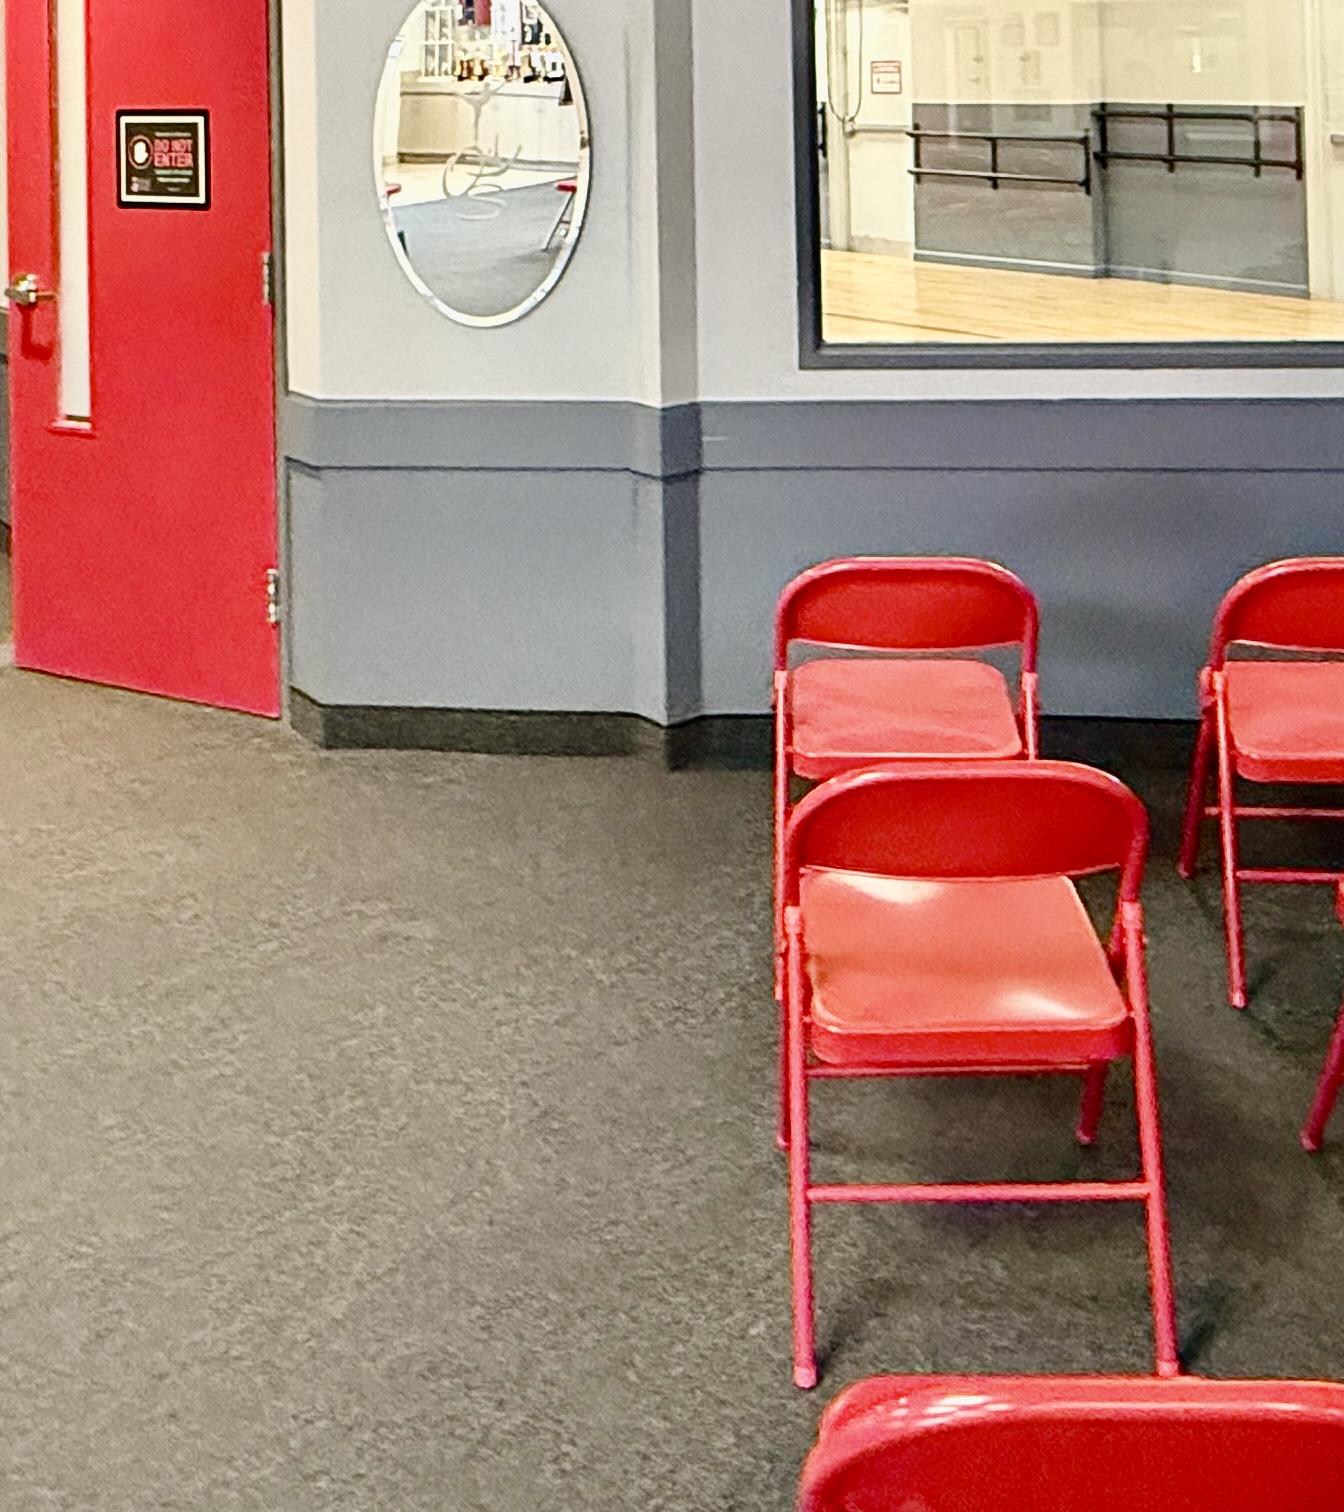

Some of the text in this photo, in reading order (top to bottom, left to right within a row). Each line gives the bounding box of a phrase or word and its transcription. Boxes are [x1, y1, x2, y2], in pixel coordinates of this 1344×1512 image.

[154, 139, 193, 153] DO NOT
[154, 153, 193, 167] ENTER
